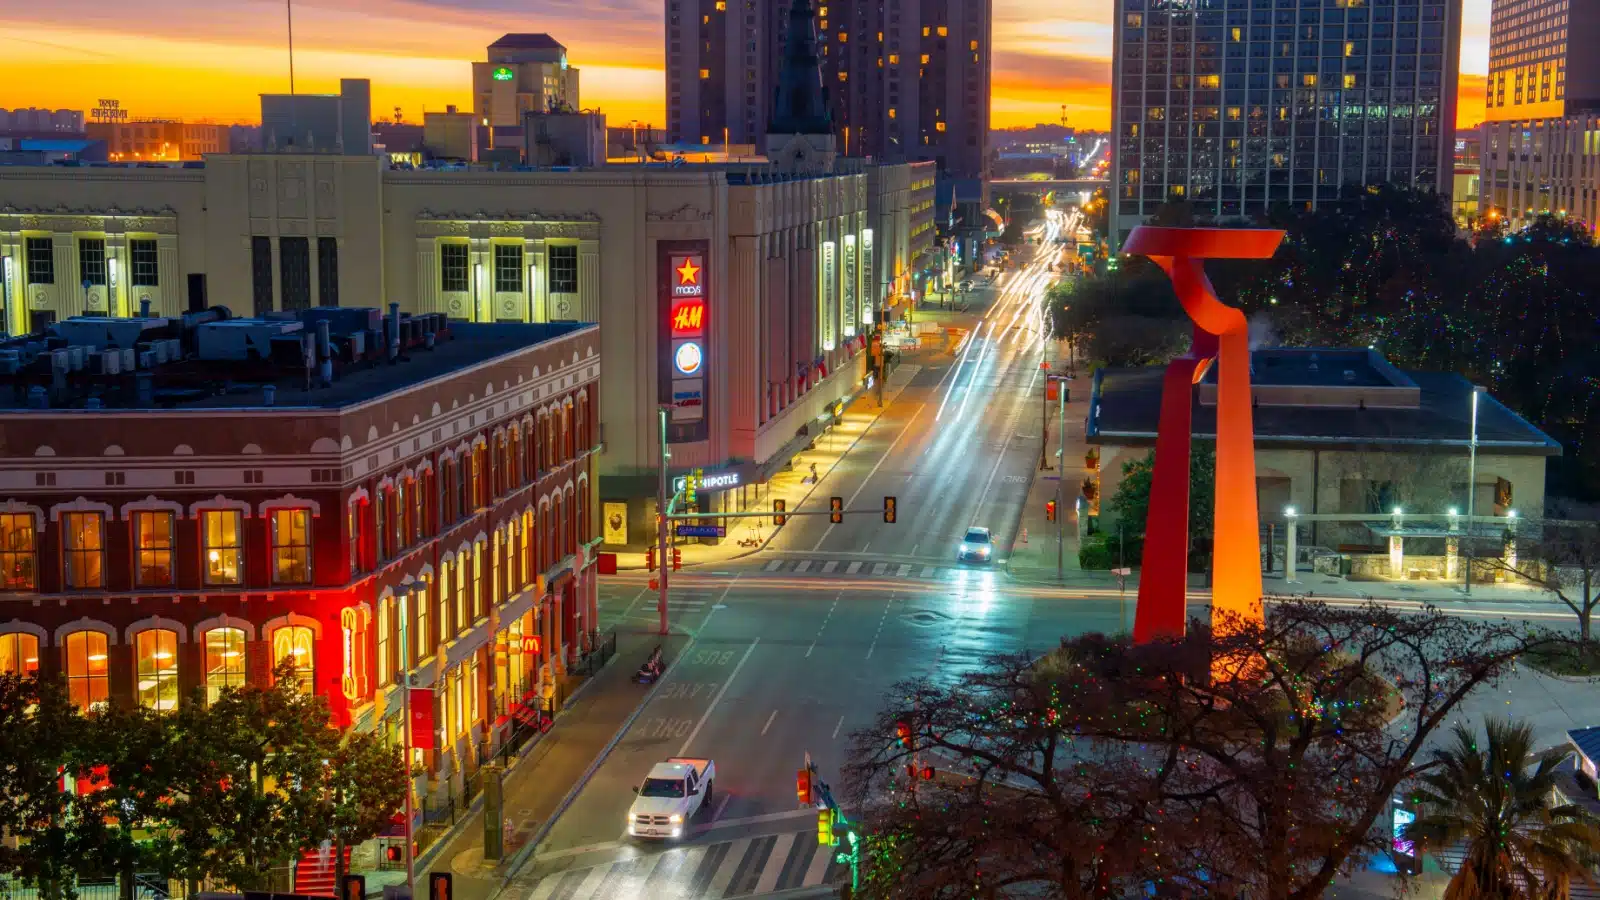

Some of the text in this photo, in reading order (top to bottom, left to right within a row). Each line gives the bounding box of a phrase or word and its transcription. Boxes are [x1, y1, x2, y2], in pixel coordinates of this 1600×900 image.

[675, 305, 703, 329] H&M
[846, 288, 854, 327] IMAX
[692, 650, 735, 665] BUS
[659, 682, 718, 699] LANE
[636, 718, 692, 737] ONLY
